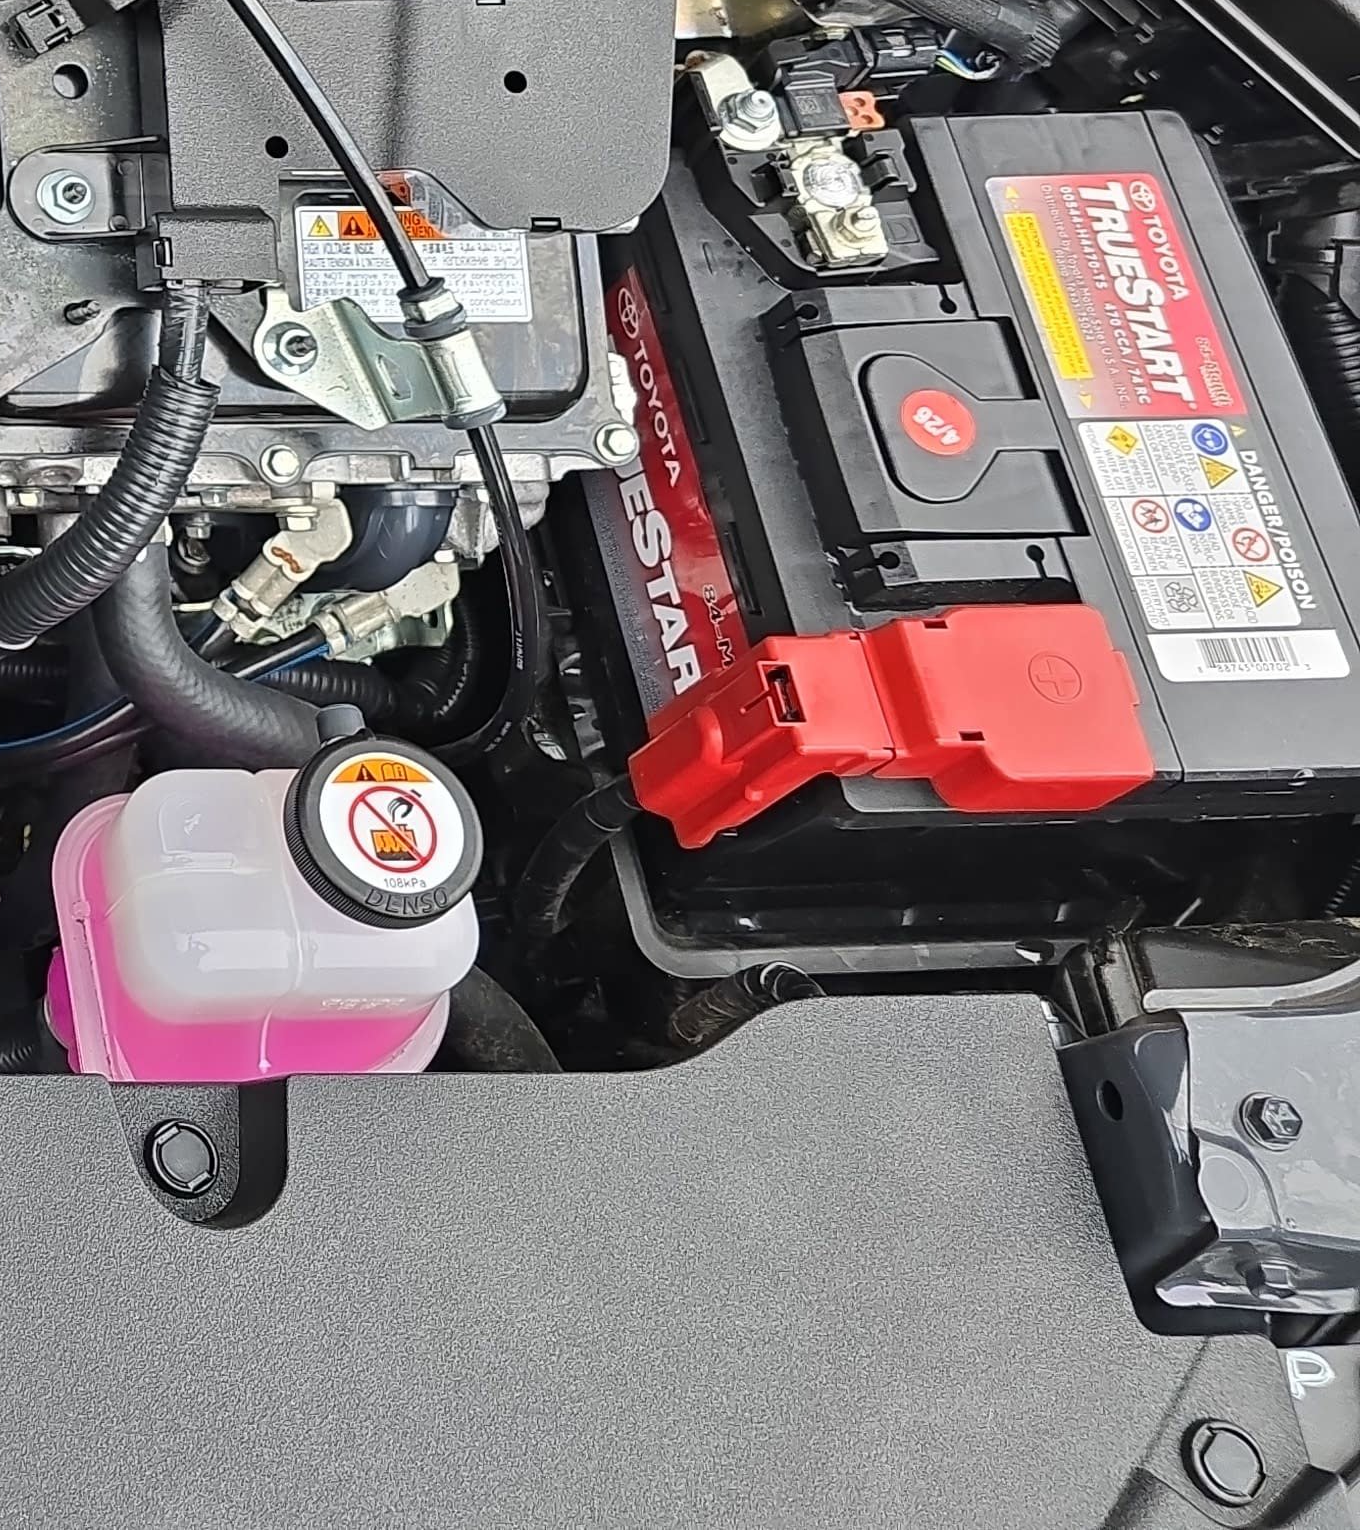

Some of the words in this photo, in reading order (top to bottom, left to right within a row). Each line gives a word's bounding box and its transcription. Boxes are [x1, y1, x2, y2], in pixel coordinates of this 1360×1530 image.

[1140, 215, 1192, 300] TOYOTA
[326, 272, 342, 280] NOT
[1103, 303, 1123, 325] 470
[1113, 329, 1134, 354] CCA
[1128, 368, 1145, 383] 74
[1135, 386, 1152, 403] RC
[635, 340, 680, 487] TOYOTA
[1239, 450, 1315, 608] DANGER/POISON
[1255, 662, 1290, 671] 00702
[383, 877, 427, 889] 108kPa
[365, 887, 450, 915] DENSO
[1285, 1349, 1336, 1399] P
